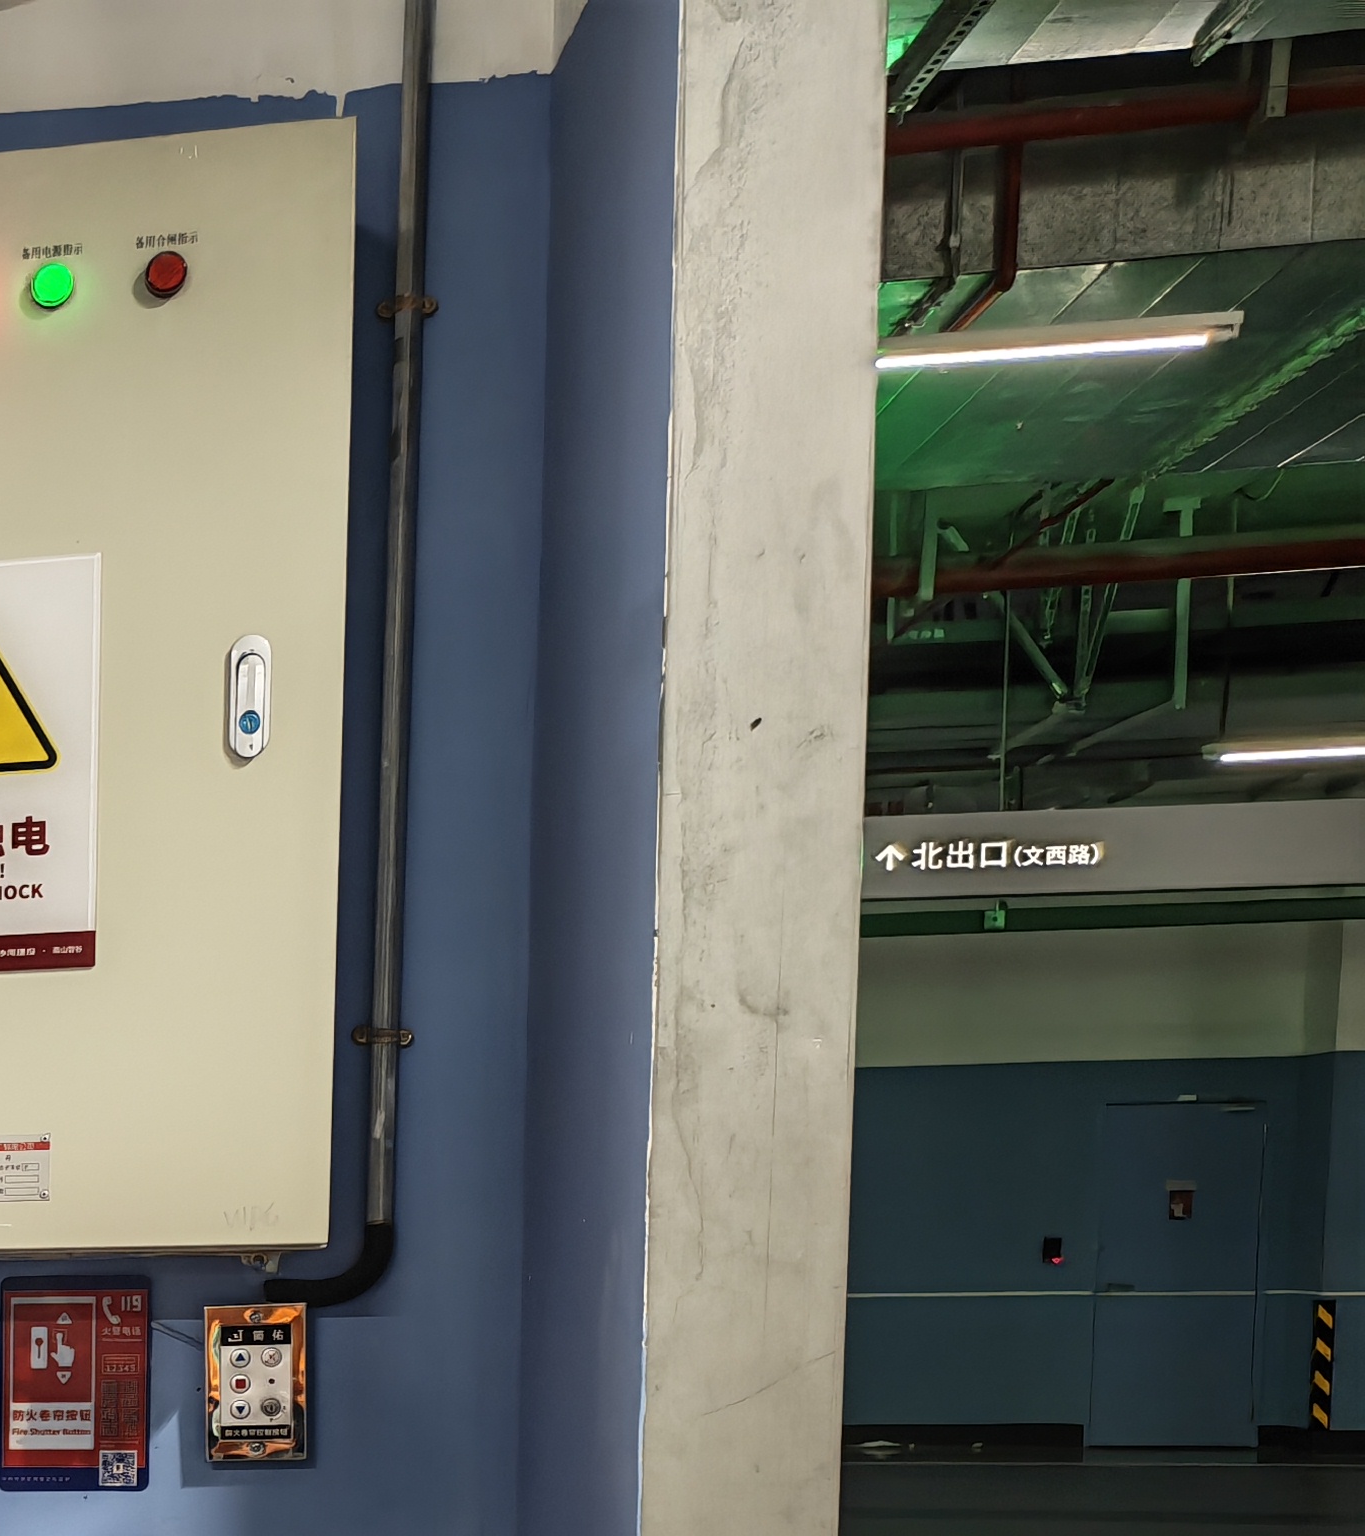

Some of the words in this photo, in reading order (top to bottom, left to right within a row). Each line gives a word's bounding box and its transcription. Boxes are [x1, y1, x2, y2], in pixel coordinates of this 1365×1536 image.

[910, 841, 1103, 871] 北出口(文西路)
[121, 1295, 142, 1312] 119
[12, 1409, 92, 1422] 防火卷帘按钮
[12, 1428, 28, 1436] Fire
